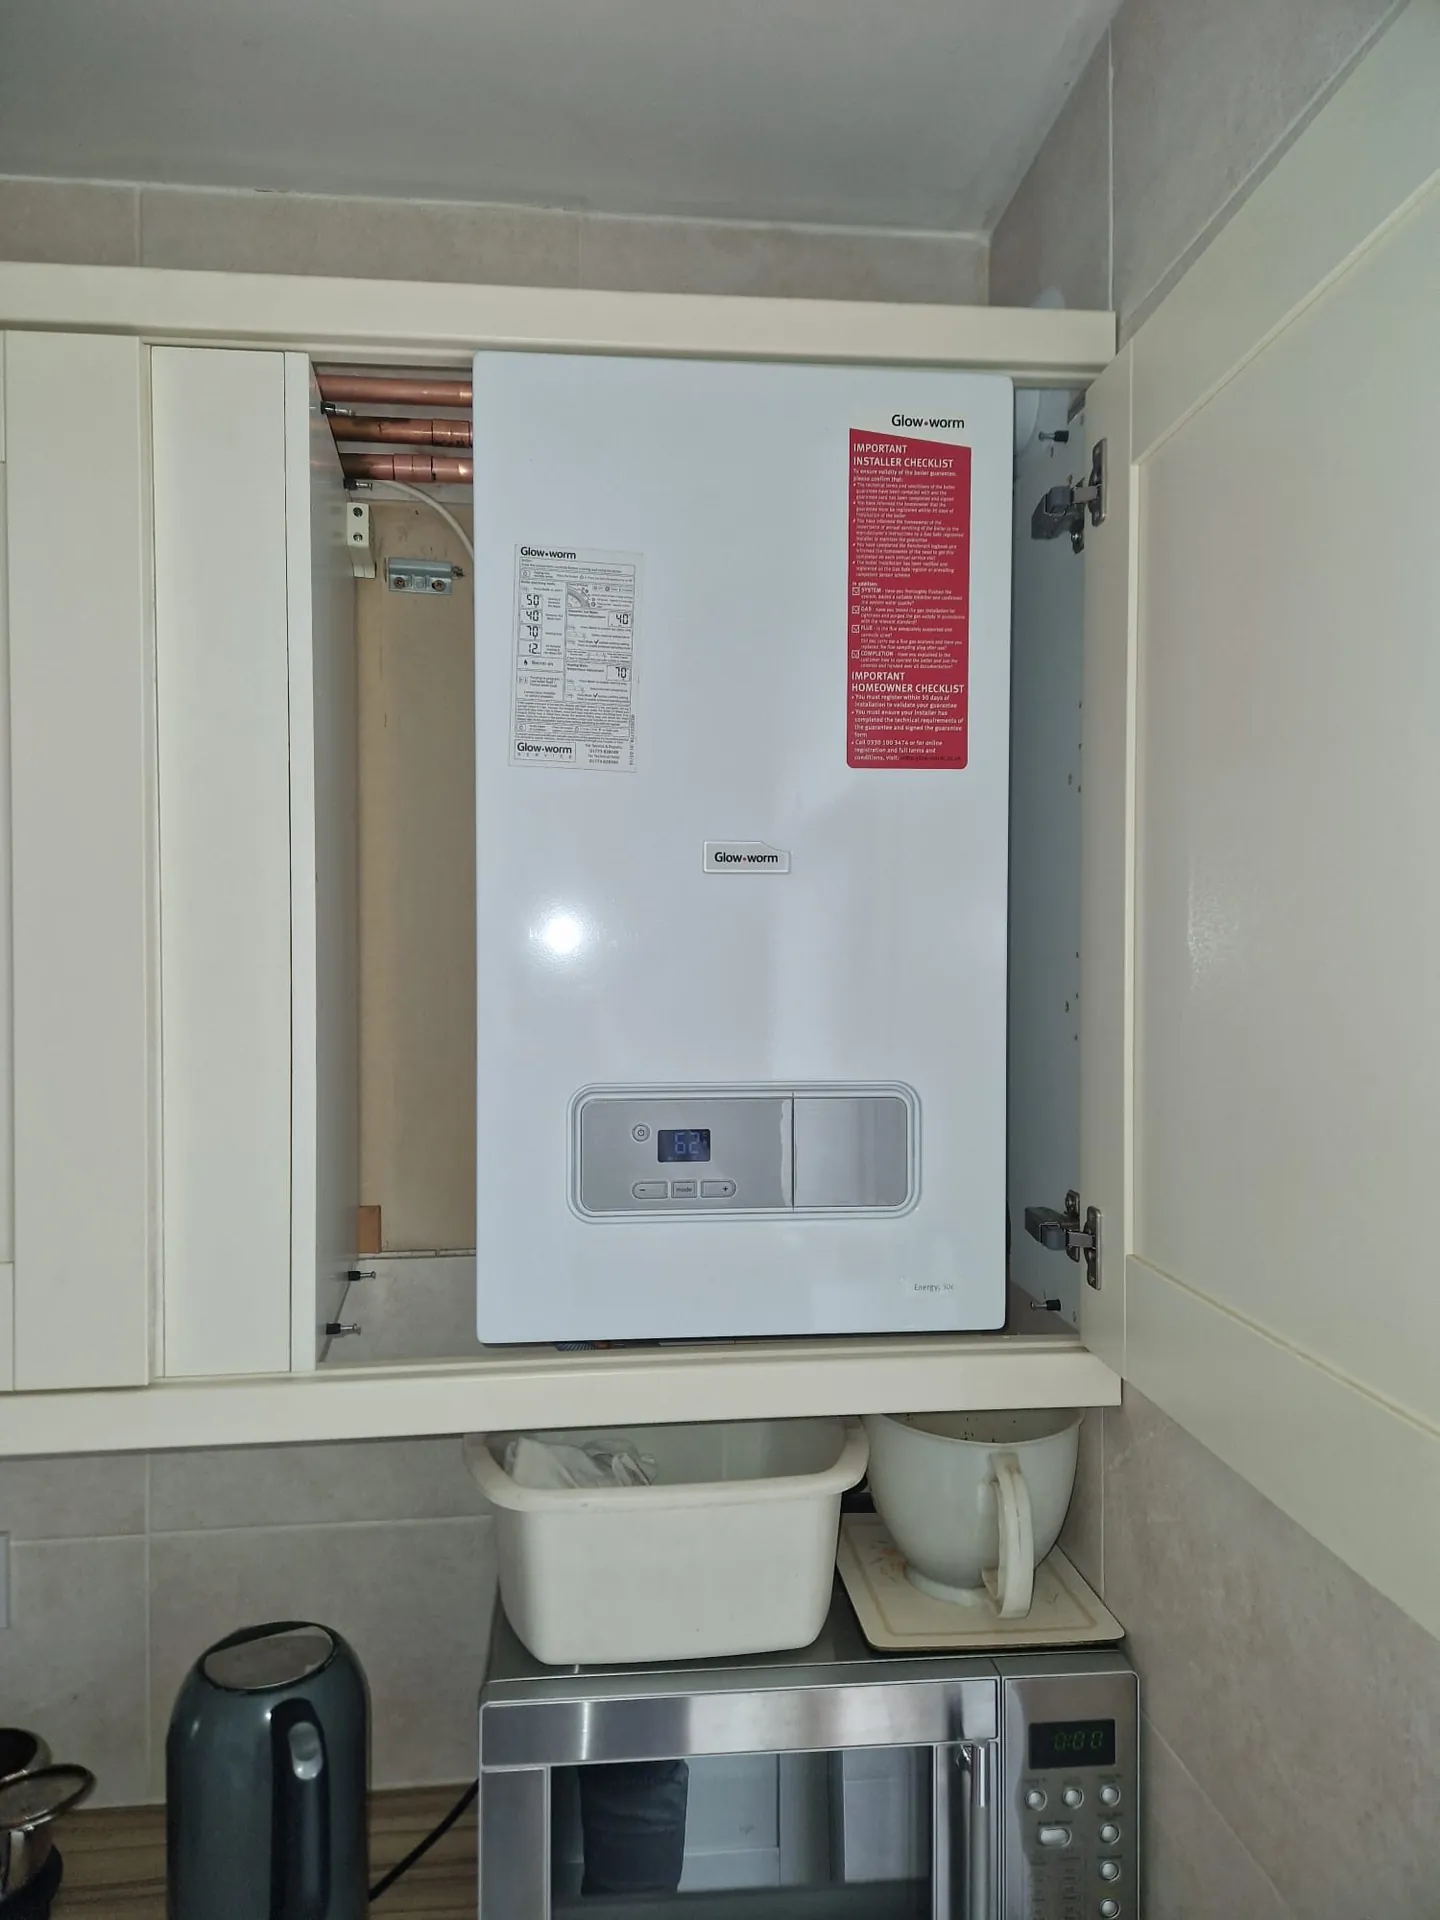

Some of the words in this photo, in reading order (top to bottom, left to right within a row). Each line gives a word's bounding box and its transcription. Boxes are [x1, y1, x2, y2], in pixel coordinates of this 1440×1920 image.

[853, 443, 907, 453] IMPORTANT
[853, 457, 902, 466] INSTALLER
[904, 458, 953, 468] CHECKLIST
[526, 594, 540, 606] 50
[526, 610, 539, 622] 40
[526, 625, 539, 638] 70
[528, 643, 538, 655] 12
[851, 672, 905, 680] IMPORTANT
[852, 683, 913, 692] HOMEOWNER
[916, 684, 964, 693] CHECKLIST
[675, 1131, 700, 1154] 62
